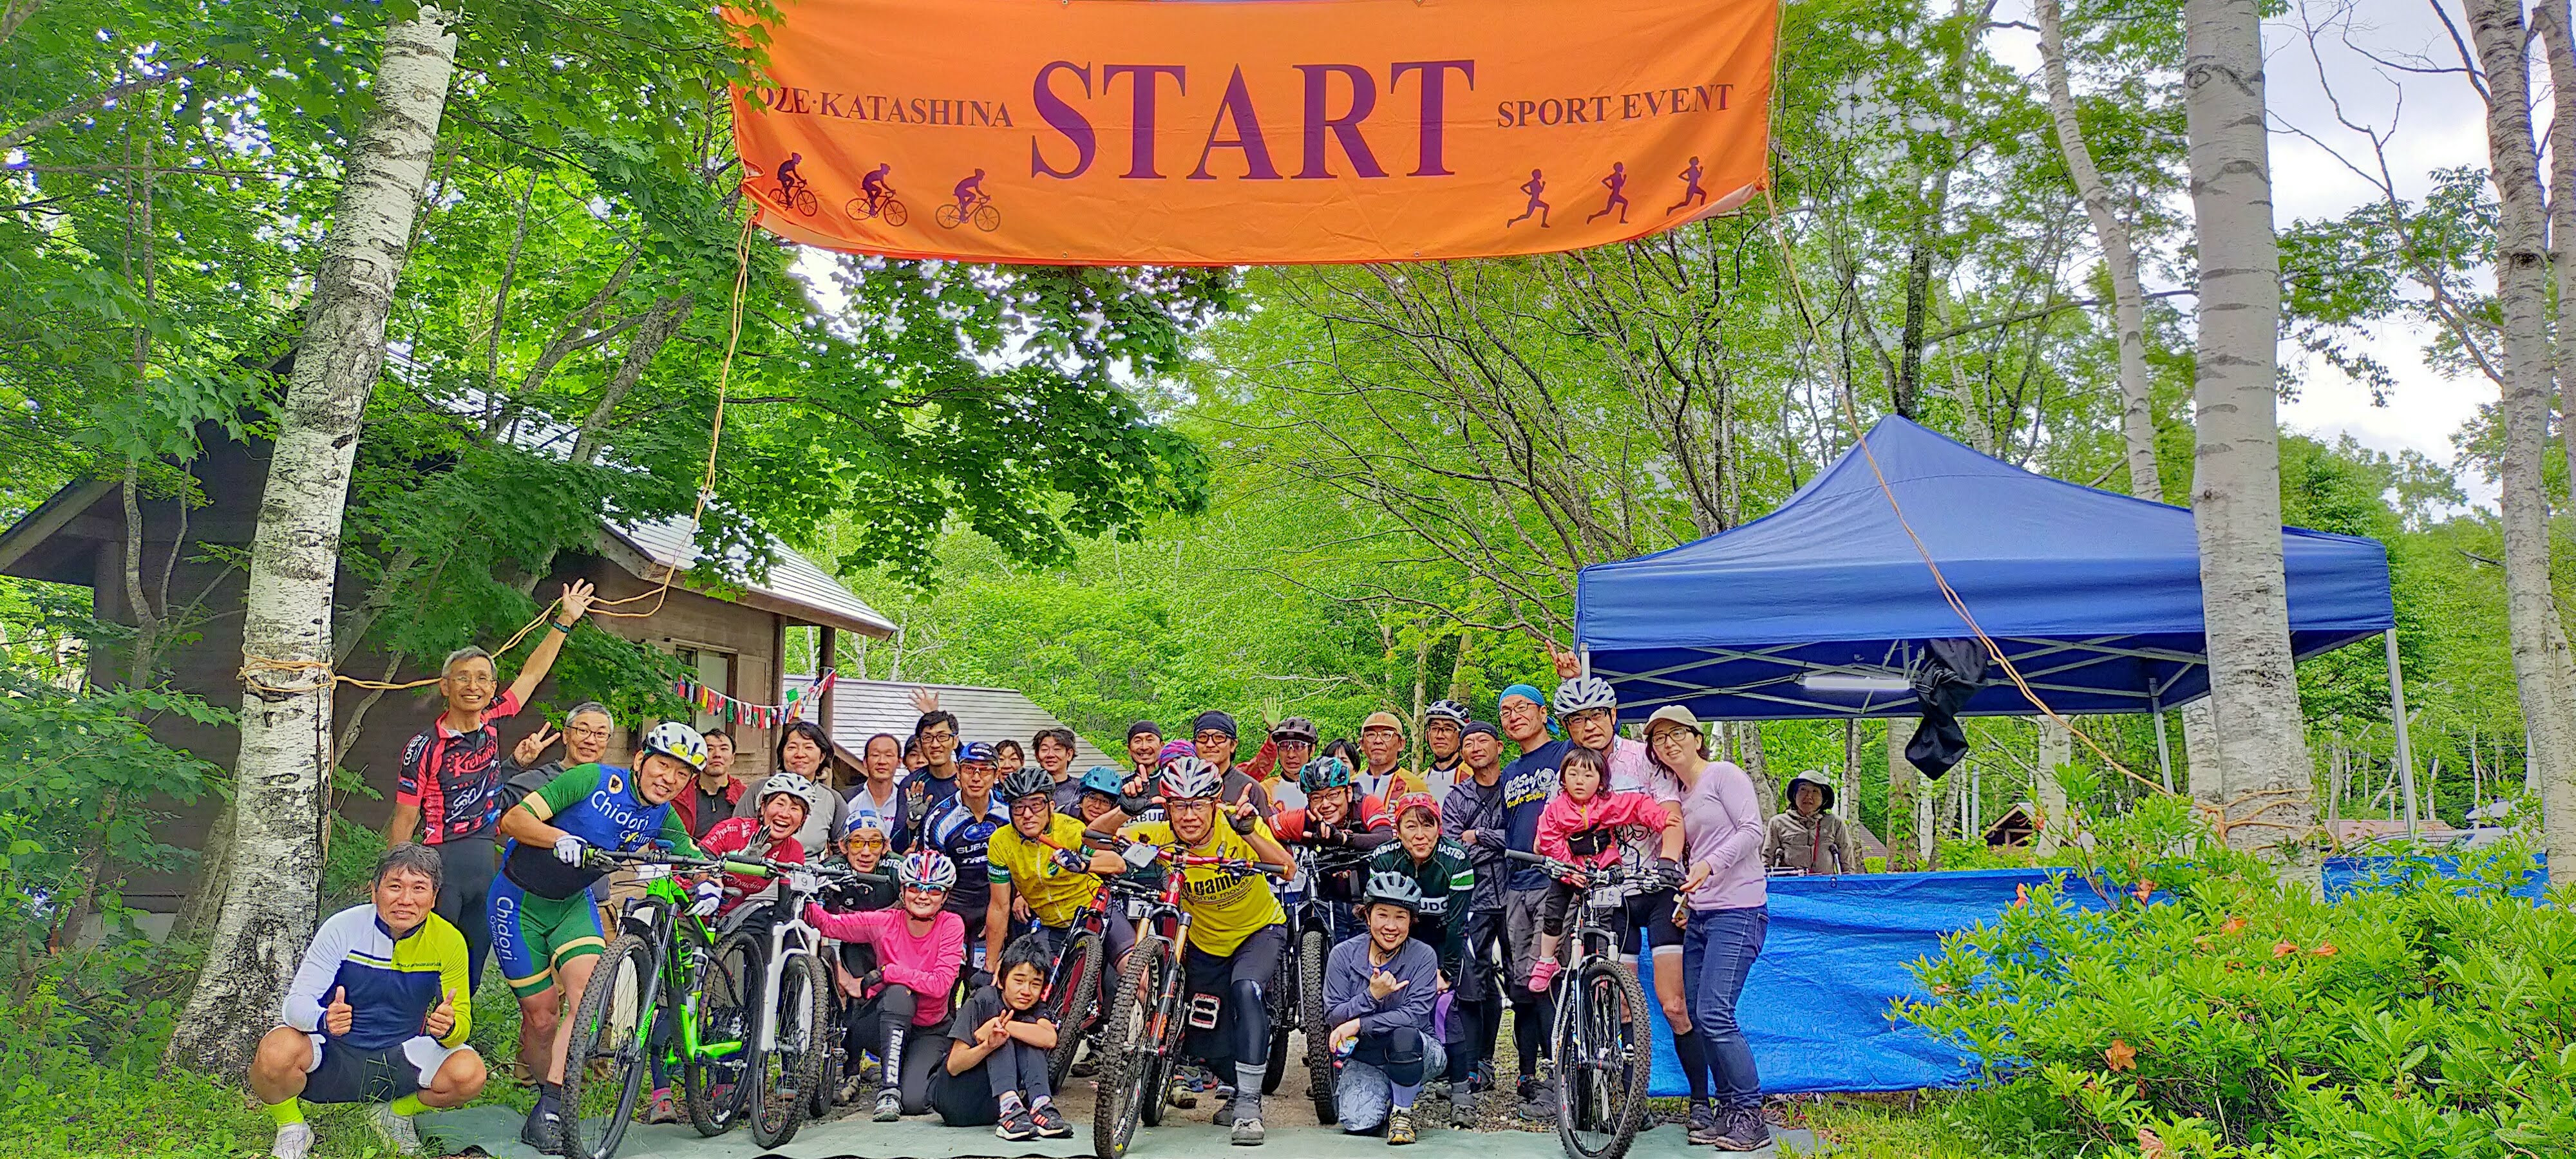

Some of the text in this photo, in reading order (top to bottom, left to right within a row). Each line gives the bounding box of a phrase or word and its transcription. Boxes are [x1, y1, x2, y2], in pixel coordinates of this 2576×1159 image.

[1032, 60, 1475, 179] START
[1497, 84, 1734, 127] SPORT EVENT
[591, 790, 649, 831] Chidori
[956, 841, 988, 854] SUBA
[961, 855, 988, 864] TRE
[800, 877, 808, 887] 9
[497, 896, 518, 961] Chidori
[887, 1030, 904, 1085] TRIMTEX
